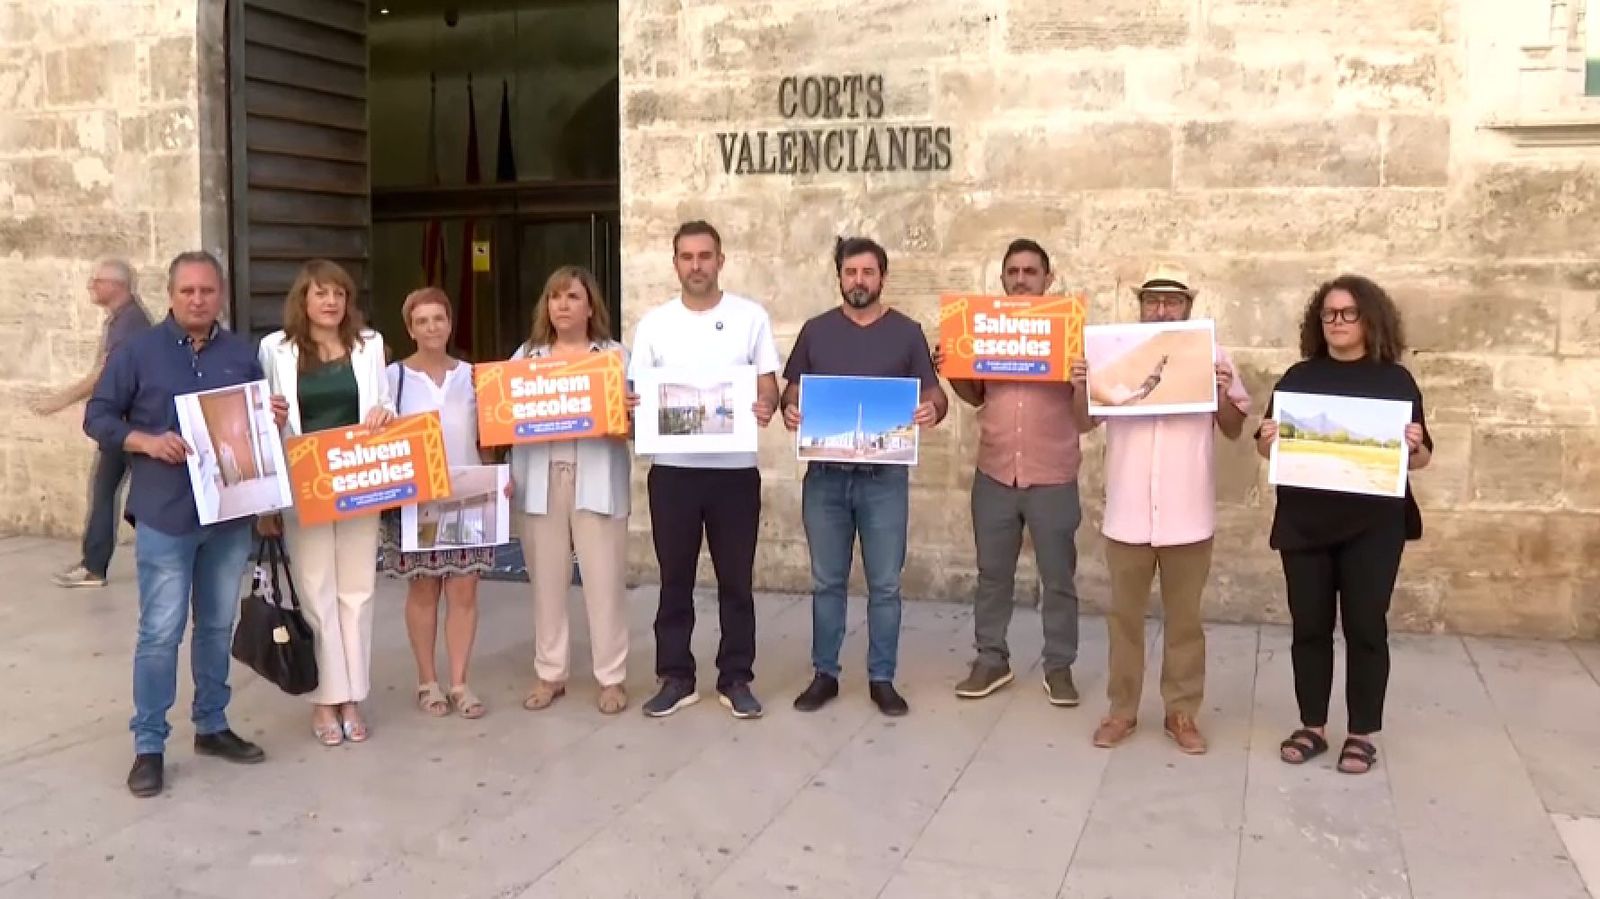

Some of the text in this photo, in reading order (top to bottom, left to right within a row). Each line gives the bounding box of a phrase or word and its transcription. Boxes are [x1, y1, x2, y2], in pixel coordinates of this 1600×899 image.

[778, 74, 884, 119] CORTS
[716, 126, 952, 175] VALENCIANES
[974, 312, 1051, 335] Salvem
[974, 335, 1051, 357] escoles
[510, 374, 590, 398] Salvem
[512, 394, 592, 419] escoles
[327, 438, 411, 471] Salvem
[331, 460, 415, 493] escoles
